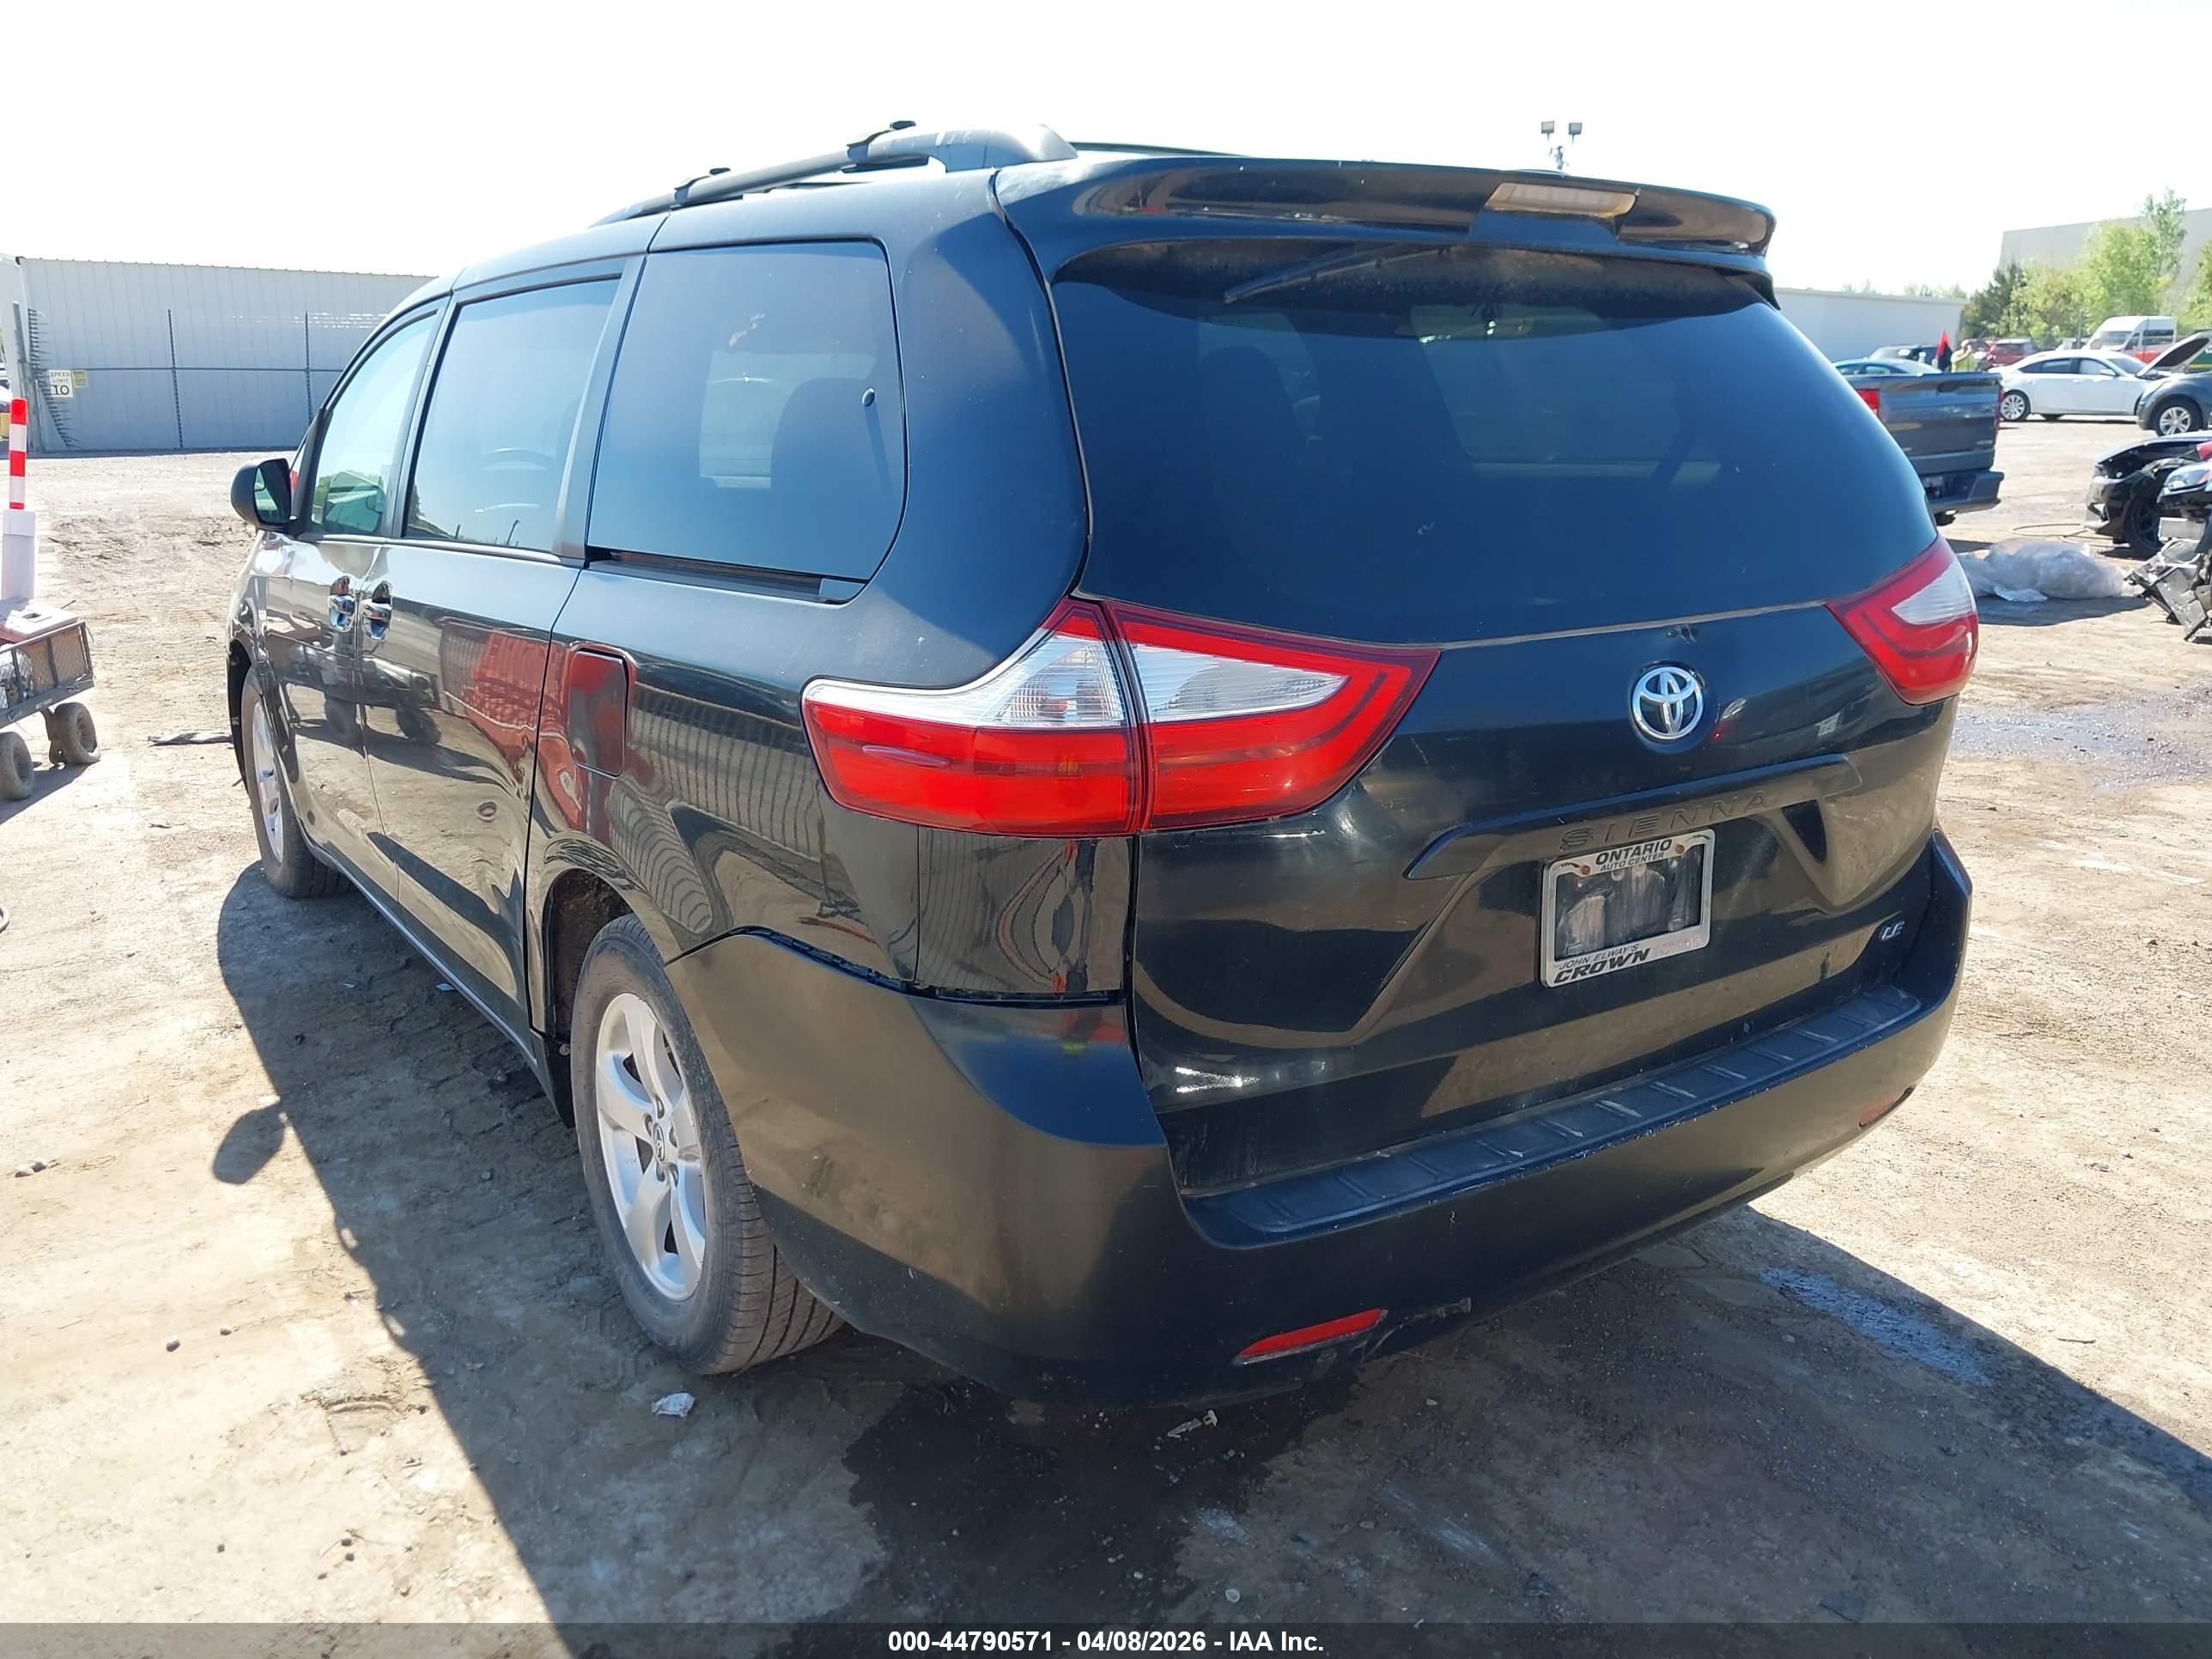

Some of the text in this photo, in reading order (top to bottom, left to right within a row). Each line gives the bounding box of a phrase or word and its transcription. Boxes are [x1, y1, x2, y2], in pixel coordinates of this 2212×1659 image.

[52, 385, 70, 395] 10
[1559, 790, 1766, 851] SIENNA
[1595, 839, 1672, 865] ONTARIO
[1600, 852, 1664, 872] AUTO CENTER
[1554, 947, 1650, 983] CROWN
[1559, 956, 1590, 970] JOHN
[1594, 944, 1639, 960] ELWAY'S
